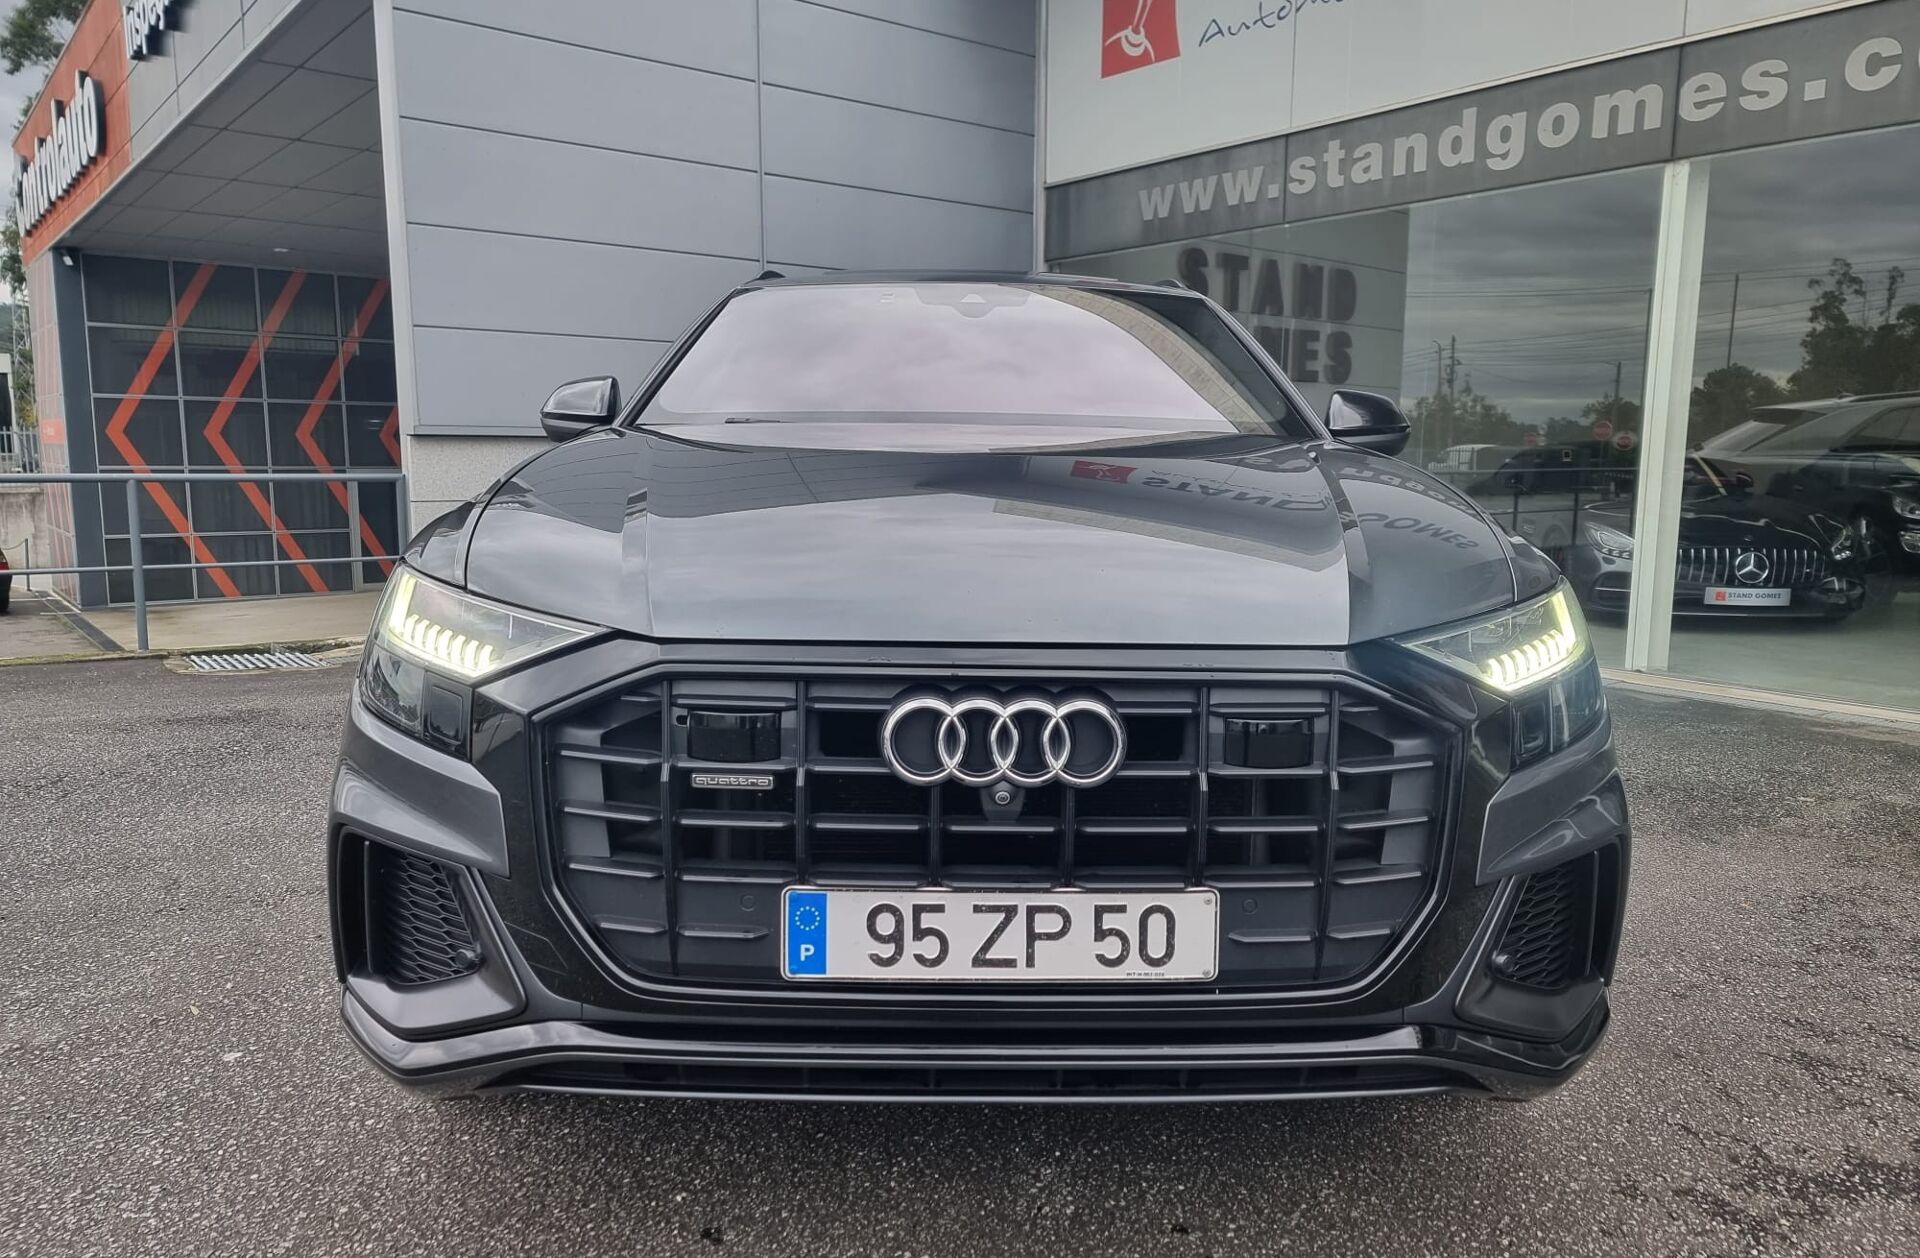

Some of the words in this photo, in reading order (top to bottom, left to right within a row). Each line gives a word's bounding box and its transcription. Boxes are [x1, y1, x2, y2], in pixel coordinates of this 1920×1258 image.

[1198, 0, 1344, 47] Auto
[1139, 36, 1920, 221] www.standgomes.c
[1252, 325, 1353, 385] MES
[1727, 591, 1754, 600] STAND
[695, 776, 769, 787] quattro
[799, 944, 815, 962] P
[866, 902, 950, 969] 95
[971, 903, 1073, 969] ZP
[1093, 903, 1177, 969] 50
